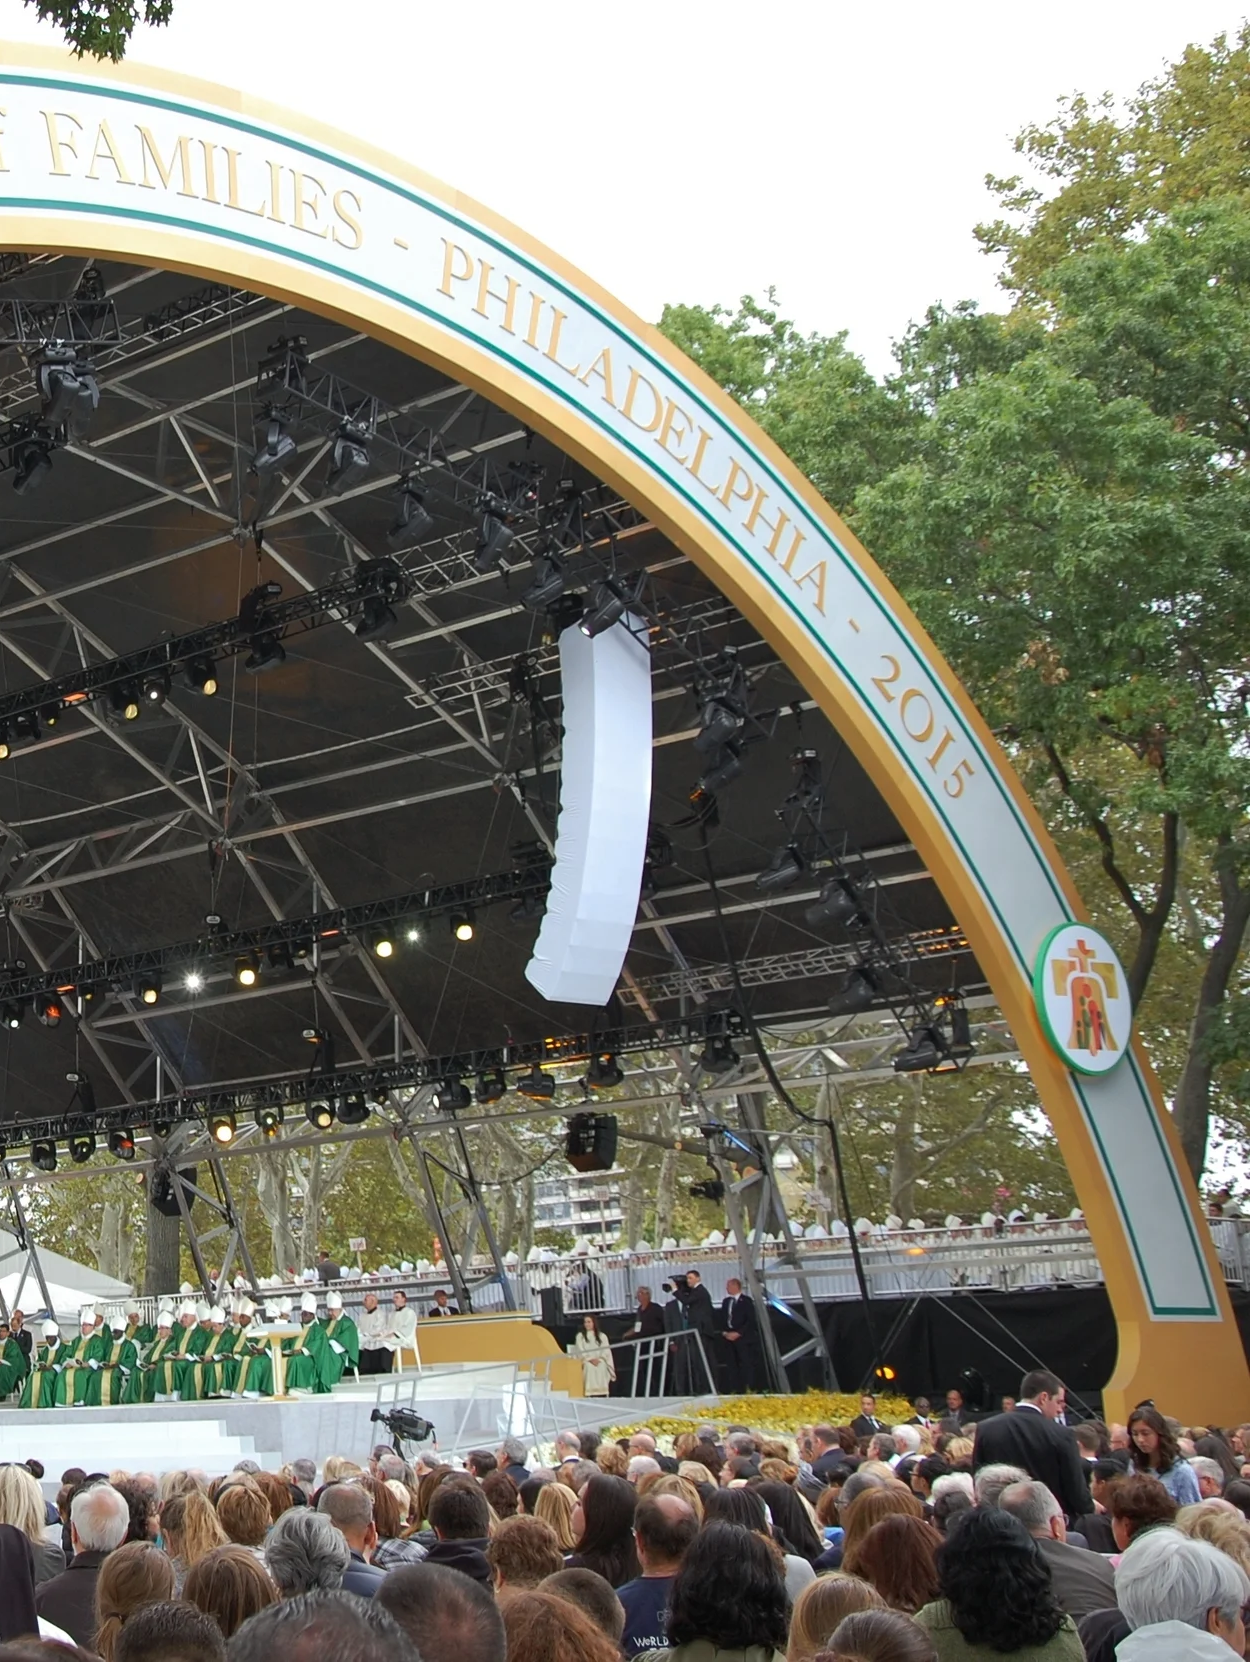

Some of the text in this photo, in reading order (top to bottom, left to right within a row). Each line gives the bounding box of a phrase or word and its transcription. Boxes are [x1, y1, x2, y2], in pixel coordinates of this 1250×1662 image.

[39, 109, 365, 250] FAMILIES
[436, 237, 831, 617] PHILADELPHIA
[871, 653, 976, 799] 2015
[633, 1636, 669, 1647] WORLD
